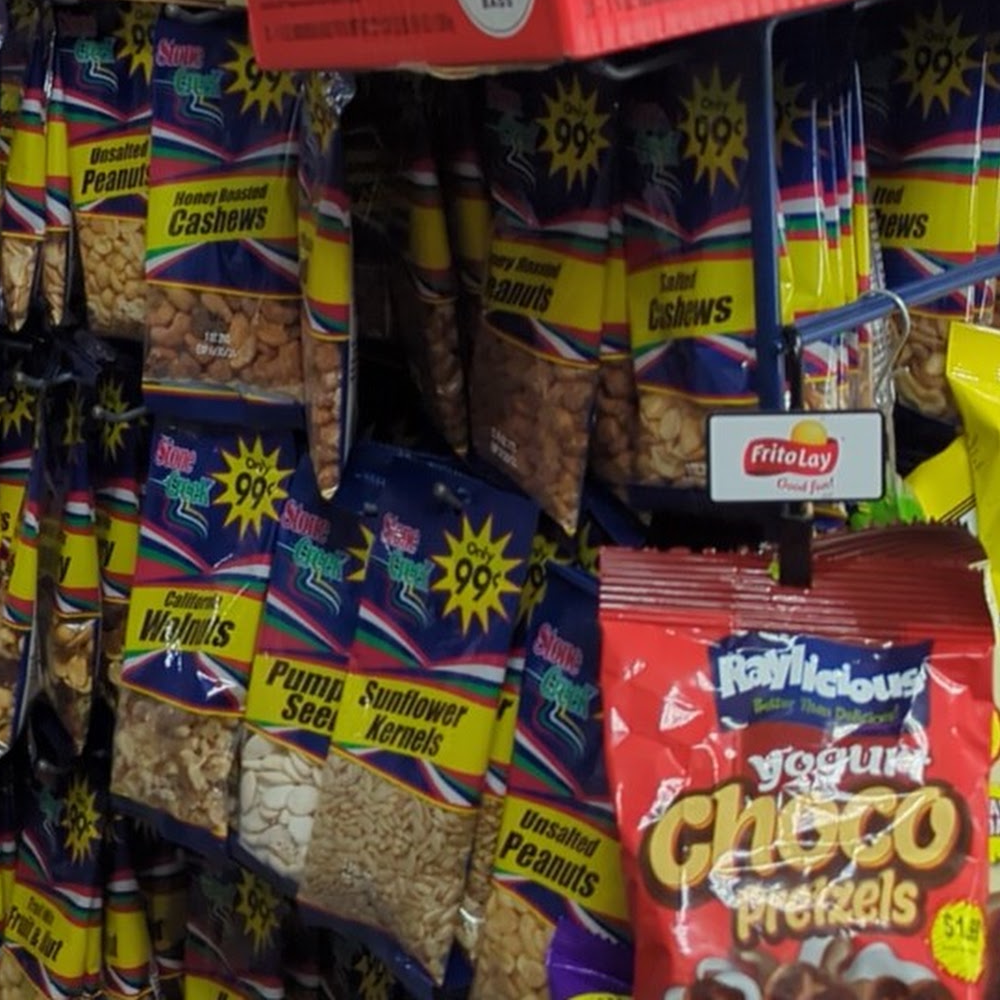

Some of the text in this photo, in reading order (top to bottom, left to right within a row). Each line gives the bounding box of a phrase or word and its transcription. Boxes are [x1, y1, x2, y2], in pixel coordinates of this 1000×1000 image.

[156, 38, 204, 68] Stone
[173, 68, 225, 98] Creek
[90, 140, 148, 165] Unsalted
[173, 184, 268, 207] Honey Roasted
[168, 205, 268, 237] Cashews
[515, 257, 562, 279] Roasted
[659, 270, 697, 293] Salted
[488, 273, 553, 314] eanuts
[648, 295, 733, 331] Cashews
[155, 435, 197, 474] Stone
[246, 457, 271, 475] Only
[164, 470, 216, 508] Creek
[235, 473, 275, 510] 99¢
[776, 477, 835, 496] Good fun!
[281, 498, 331, 542] Stone
[380, 512, 421, 554] Stone
[293, 536, 349, 581] Creek
[387, 551, 434, 592] Creek
[467, 542, 495, 562] Only
[455, 557, 501, 602] 99¢
[164, 590, 223, 609] California
[139, 609, 236, 648] Walnuts
[533, 622, 583, 675] Stone
[266, 660, 344, 702] Pump
[539, 666, 597, 717] Creek
[717, 644, 927, 703] Raylicious
[358, 680, 468, 728] Sunflower
[752, 697, 796, 715] Better
[801, 699, 832, 718] Than
[365, 715, 444, 756] Kernels
[749, 742, 931, 792] yogurt
[518, 809, 600, 859] Unsalted
[499, 832, 600, 899] Peanuts
[7, 906, 35, 932] Fruit
[734, 874, 919, 943] pretzels
